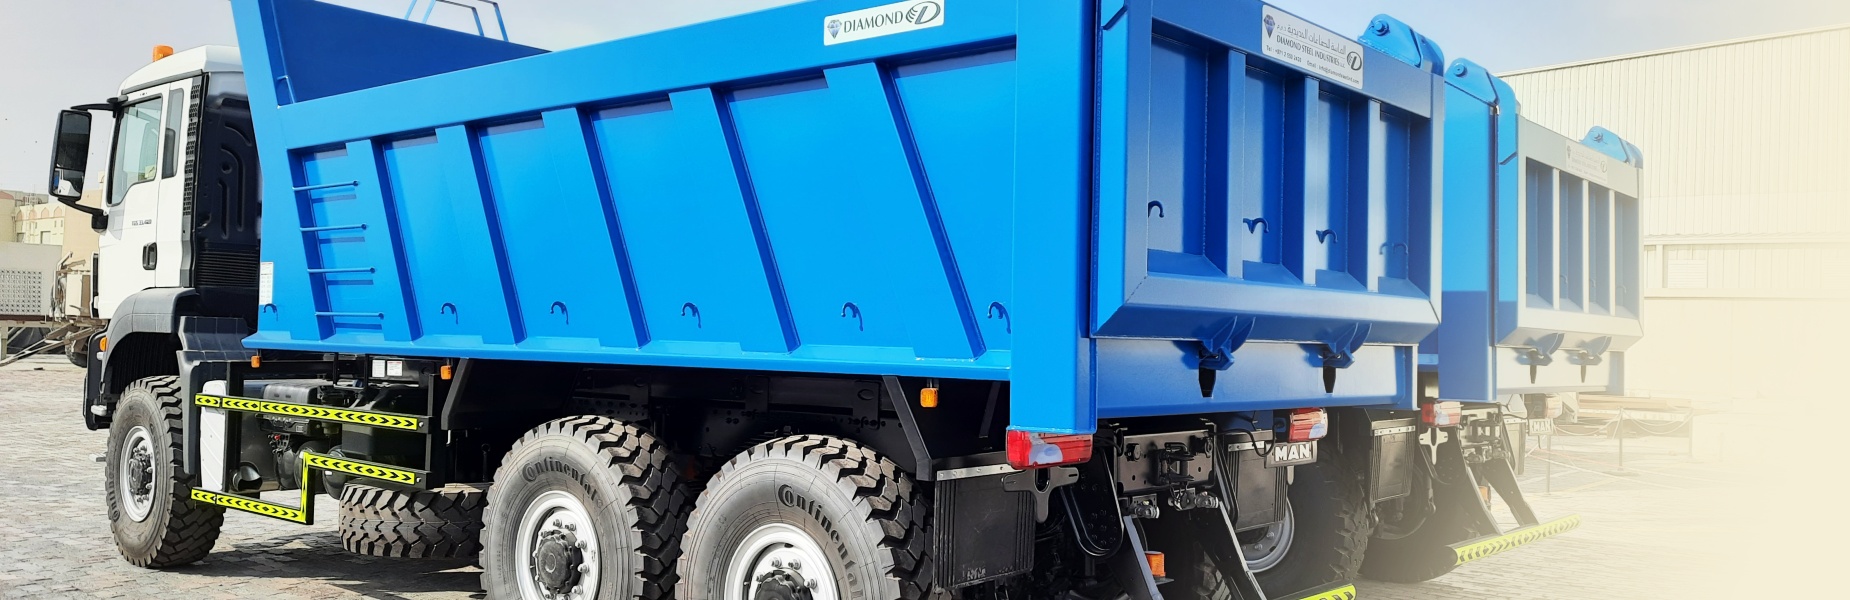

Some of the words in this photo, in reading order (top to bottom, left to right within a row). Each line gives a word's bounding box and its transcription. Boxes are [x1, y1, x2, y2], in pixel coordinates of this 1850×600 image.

[844, 11, 903, 33] DIAMOND
[1277, 35, 1301, 50] DIAMOND
[1302, 45, 1314, 56] STEEL
[1314, 50, 1340, 66] INDUSTRIES
[1275, 444, 1310, 461] MAN
[522, 456, 598, 501] Continental
[778, 484, 864, 599] Continental
